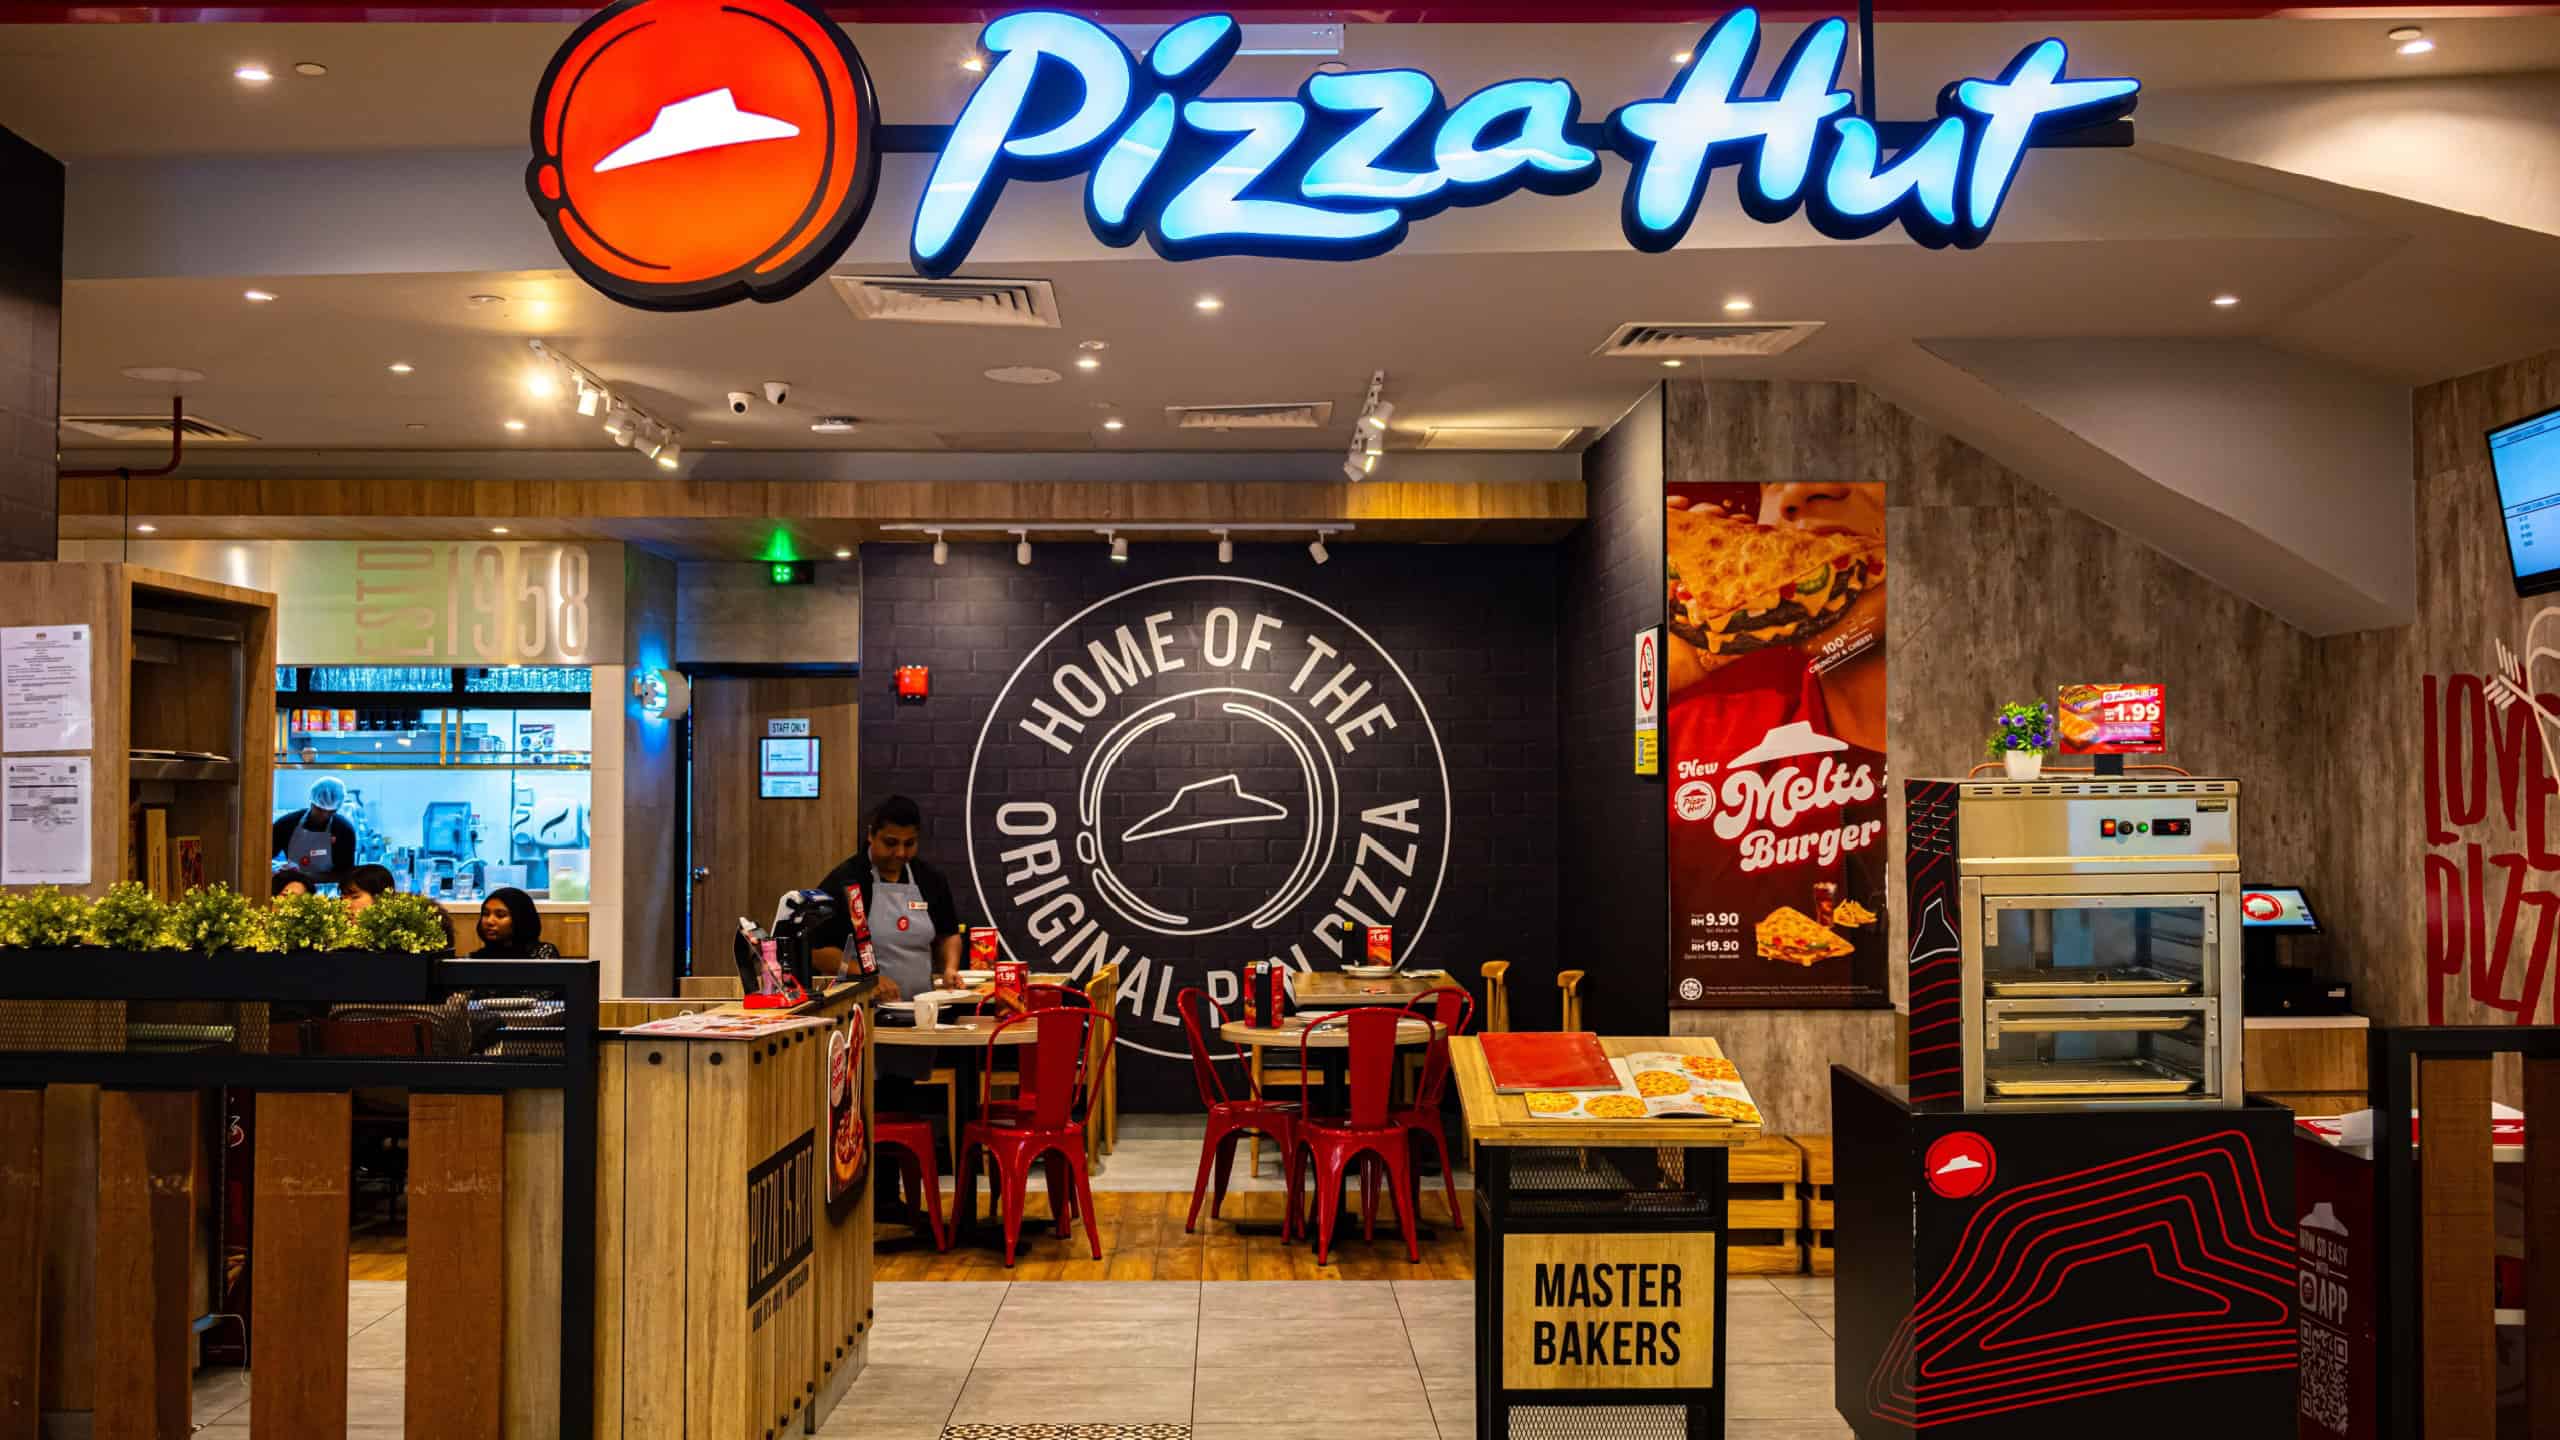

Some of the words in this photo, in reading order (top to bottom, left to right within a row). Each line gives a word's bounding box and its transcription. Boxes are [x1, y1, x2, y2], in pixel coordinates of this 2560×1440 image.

[912, 8, 1596, 260] Pizza
[1621, 7, 2141, 230] Hut
[447, 543, 589, 659] 1958
[1019, 611, 1185, 754] HOME
[1204, 607, 1283, 670] OF
[1288, 634, 1398, 753] THE
[772, 722, 790, 733] STAFF
[791, 722, 806, 733] ONLY
[2115, 702, 2160, 721] 1.99
[1677, 758, 1719, 779] New
[1713, 756, 1875, 840] Melts
[1739, 819, 1881, 872] Burger
[996, 802, 1181, 1027] ORIGINAL
[1207, 943, 1313, 1029] PN
[1691, 918, 1704, 926] RM
[1706, 913, 1739, 926] 9.90
[1691, 943, 1704, 951] RM
[1706, 940, 1739, 951] 19.90
[750, 1167, 780, 1289] PIZZA
[783, 1159, 793, 1261] IS
[794, 1145, 812, 1249] ART
[2327, 1241, 2349, 1267] EASY
[1535, 1263, 1682, 1307] MASTER
[2319, 1277, 2348, 1325] APP
[1534, 1320, 1681, 1366] BAKERS
